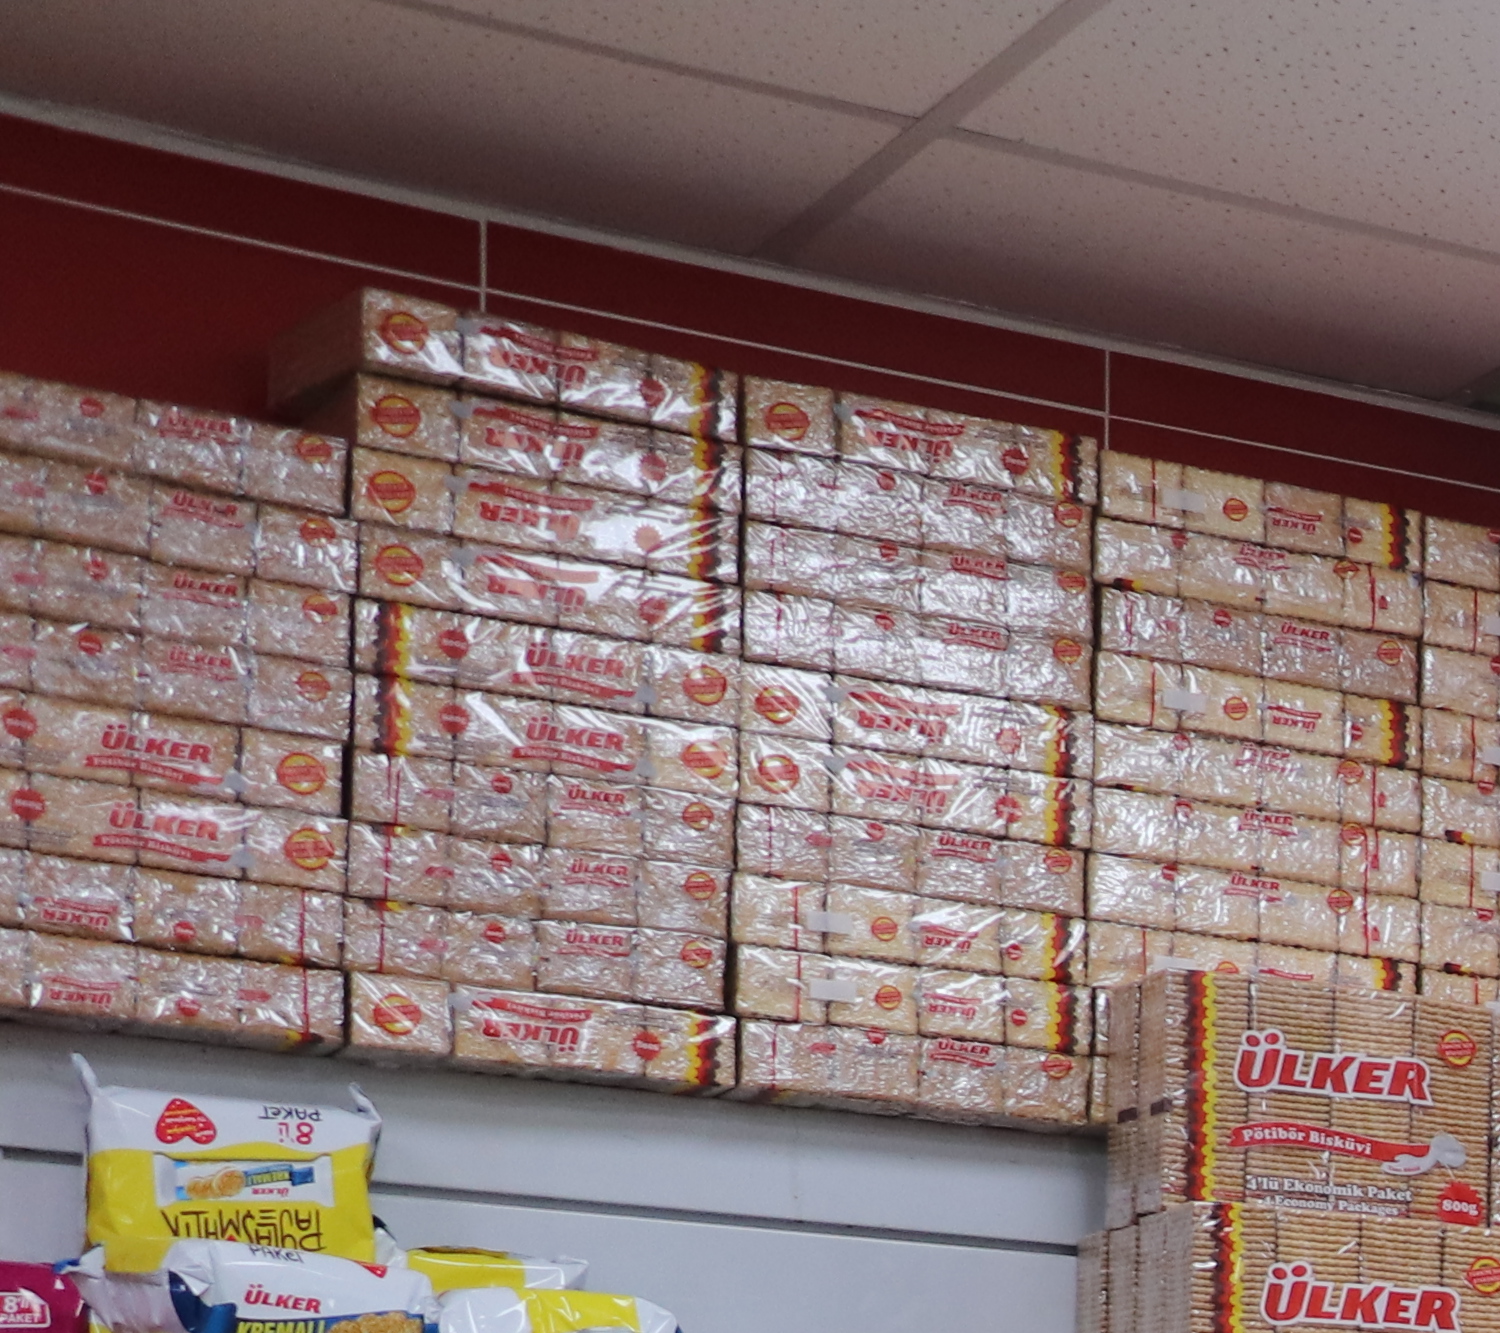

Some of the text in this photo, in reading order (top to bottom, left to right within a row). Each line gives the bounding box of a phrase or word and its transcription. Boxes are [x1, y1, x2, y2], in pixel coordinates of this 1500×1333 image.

[1281, 621, 1329, 642] ÜLKER
[525, 642, 625, 677] ÜLKER
[101, 724, 212, 763] ÜLKER
[525, 716, 625, 751] ÜLKER
[109, 802, 219, 840] ÜLKER
[938, 835, 991, 851] ÜLKER
[482, 1018, 579, 1052] ÜLKER
[1234, 1029, 1433, 1106] ÜLKER
[1242, 1127, 1372, 1155] Pötibör Bisküvi
[1284, 1179, 1364, 1198] Ekonomik
[1368, 1186, 1412, 1201] Paket
[1274, 1196, 1399, 1216] Economy Packages
[1442, 1200, 1478, 1217] 800g
[244, 1284, 321, 1313] ÜLKER
